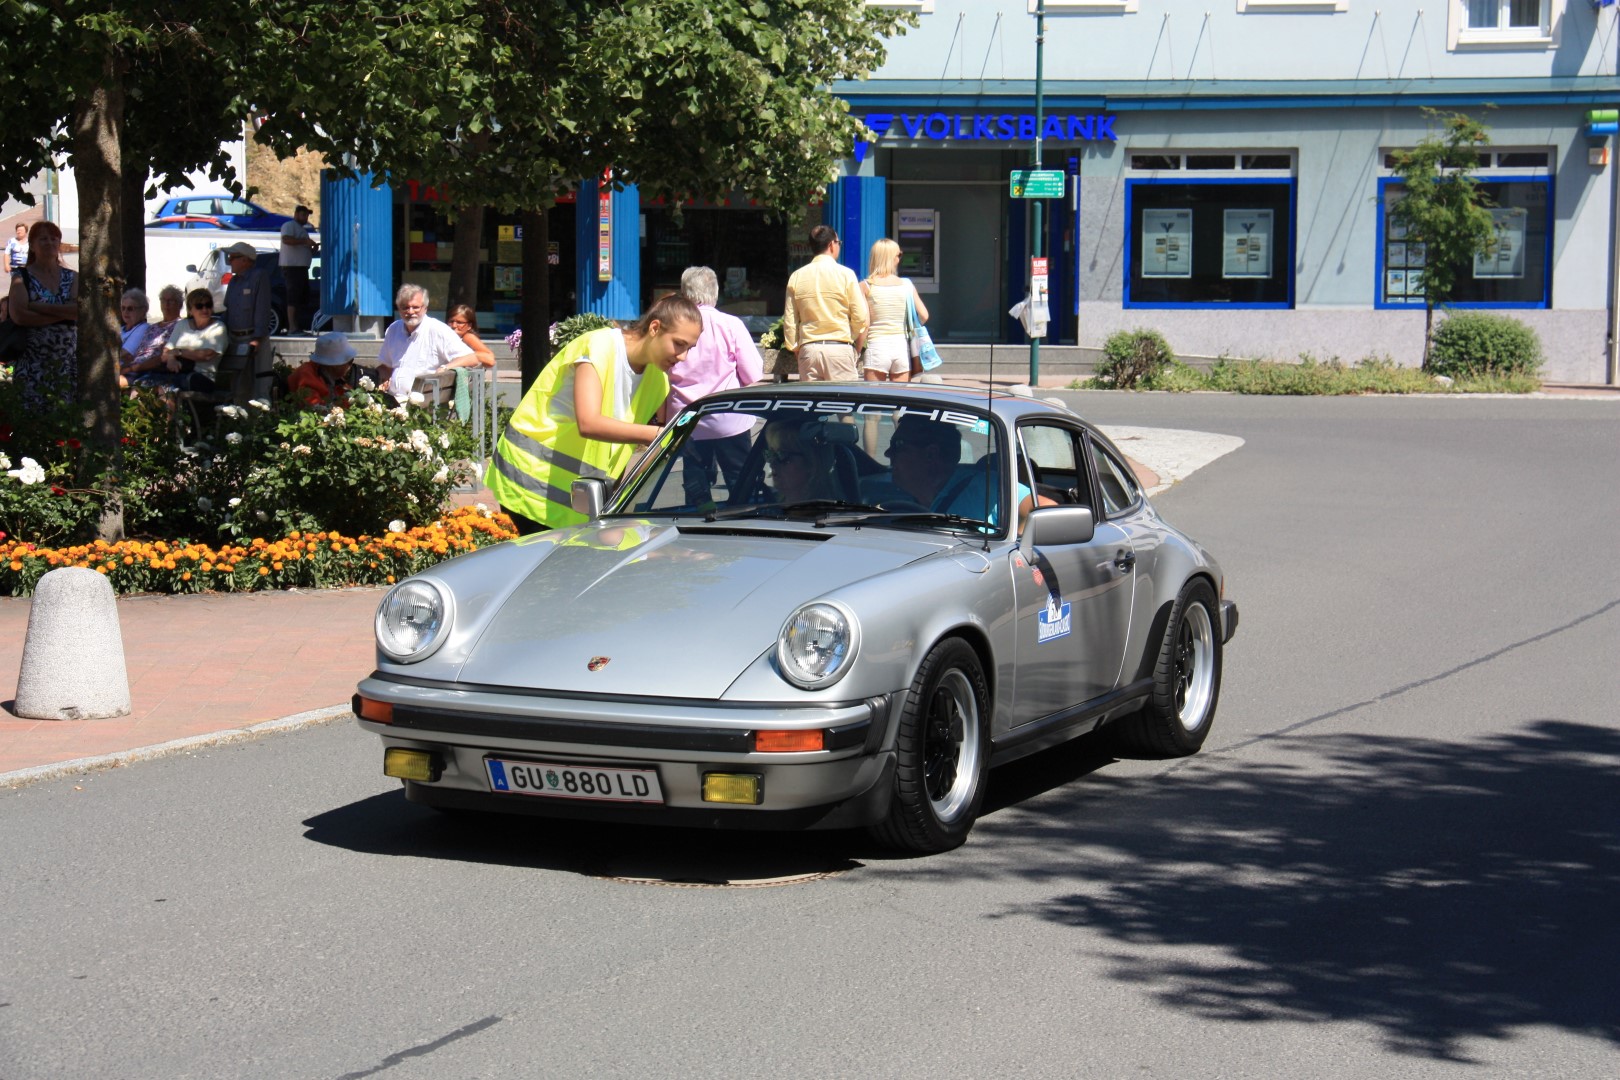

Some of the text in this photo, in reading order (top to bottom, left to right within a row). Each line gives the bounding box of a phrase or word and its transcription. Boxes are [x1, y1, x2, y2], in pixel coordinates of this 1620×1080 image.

[900, 113, 1118, 141] VOLKSBANK
[696, 400, 980, 427] PORSCHE
[497, 778, 504, 786] A
[511, 766, 650, 797] GU 880 LD
